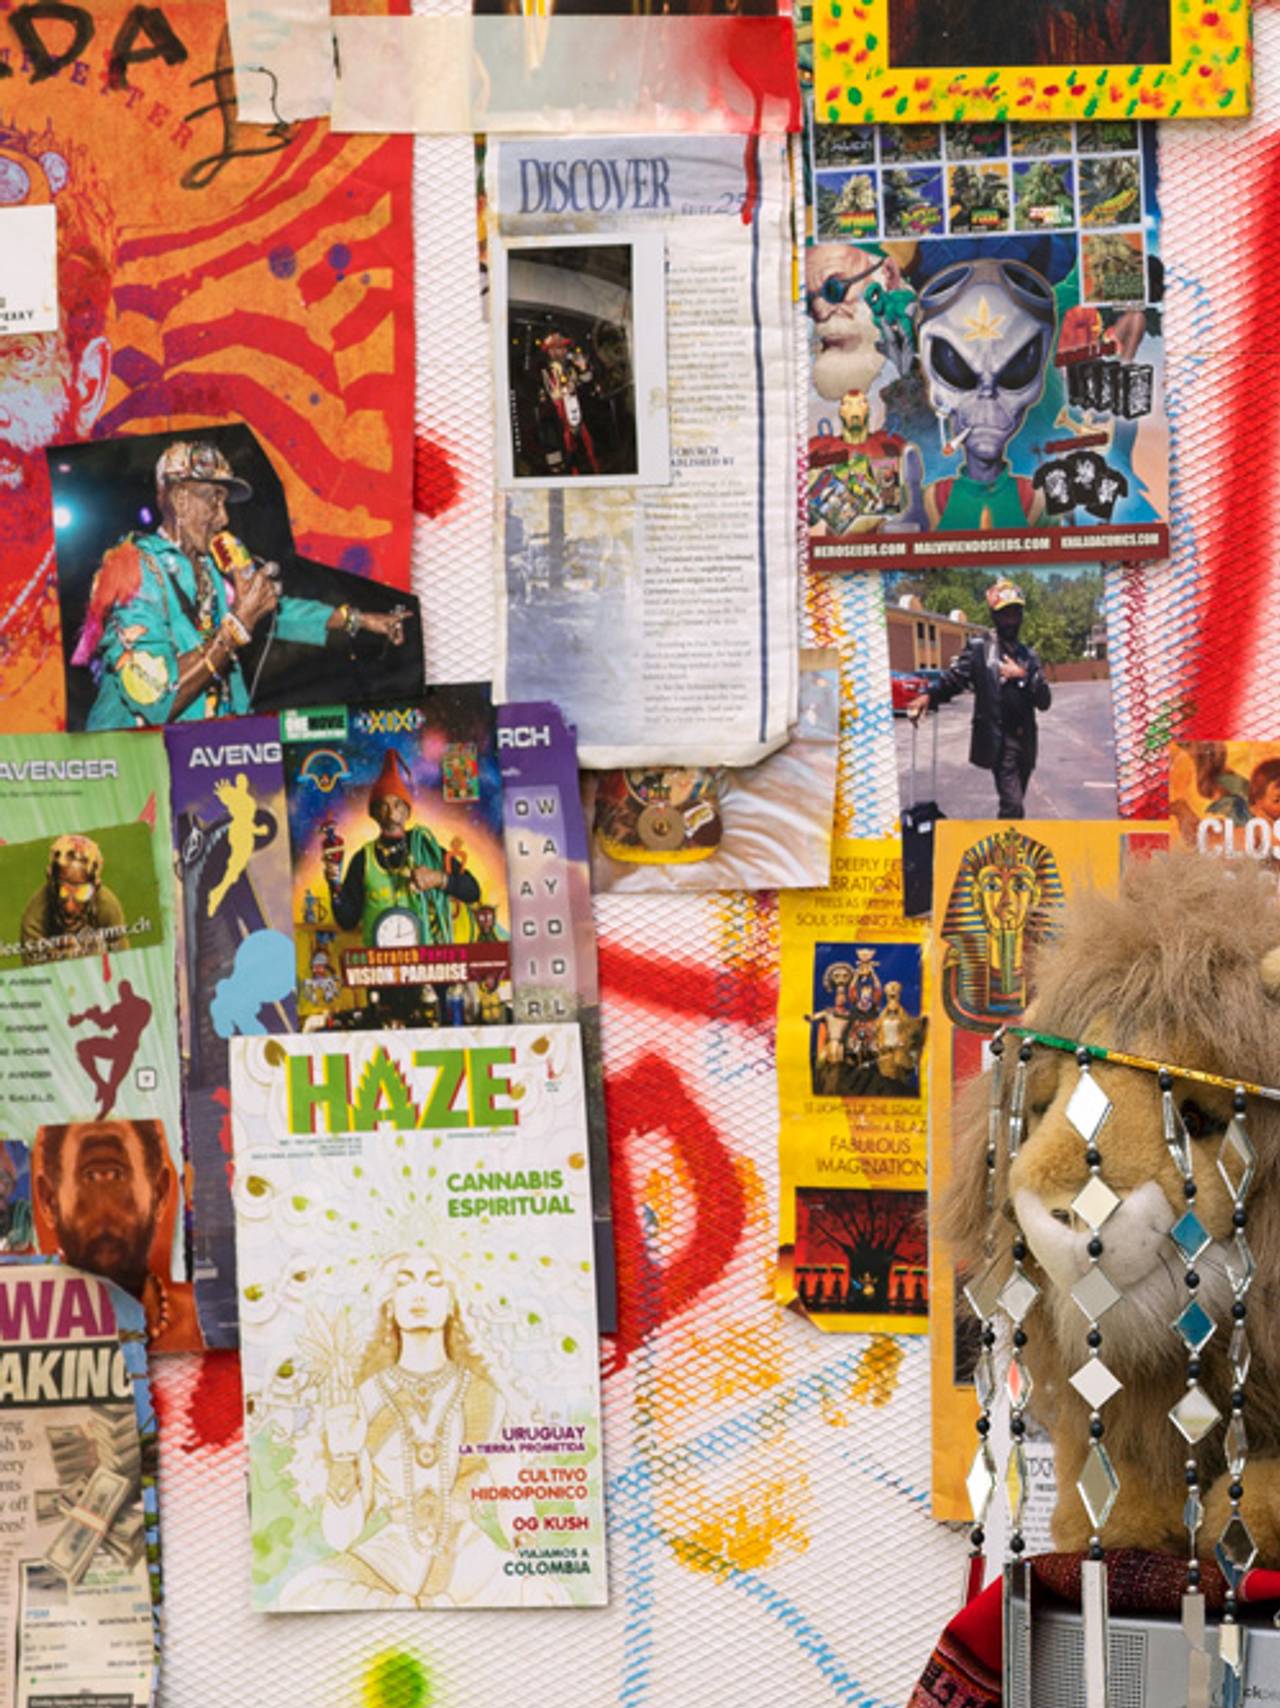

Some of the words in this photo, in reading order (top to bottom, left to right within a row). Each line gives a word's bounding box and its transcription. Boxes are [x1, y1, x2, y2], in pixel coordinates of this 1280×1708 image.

[518, 156, 671, 214] DISCOVER
[813, 542, 906, 558] HEROSEEDS.COM
[835, 857, 879, 871] DEEPLY
[346, 967, 394, 986] VISION
[400, 964, 468, 984] PARADISE
[285, 1043, 519, 1134] HAZE
[830, 1136, 912, 1153] FABULOUS
[816, 1158, 928, 1175] IMAGINATION
[447, 1170, 563, 1192] CANNABIS
[448, 1196, 575, 1218] ESPIRITUAL
[502, 1426, 585, 1441] URUGUAY
[458, 1445, 473, 1454] LA
[477, 1444, 516, 1453] TIERRA
[519, 1442, 585, 1452] PROMETIDA
[518, 1467, 587, 1483] CULTIVO
[471, 1485, 588, 1500] HIDROPONICO
[513, 1517, 538, 1531] OG
[544, 1516, 589, 1530] KUSH
[581, 1549, 589, 1557] A
[503, 1560, 591, 1576] COLOMBIA
